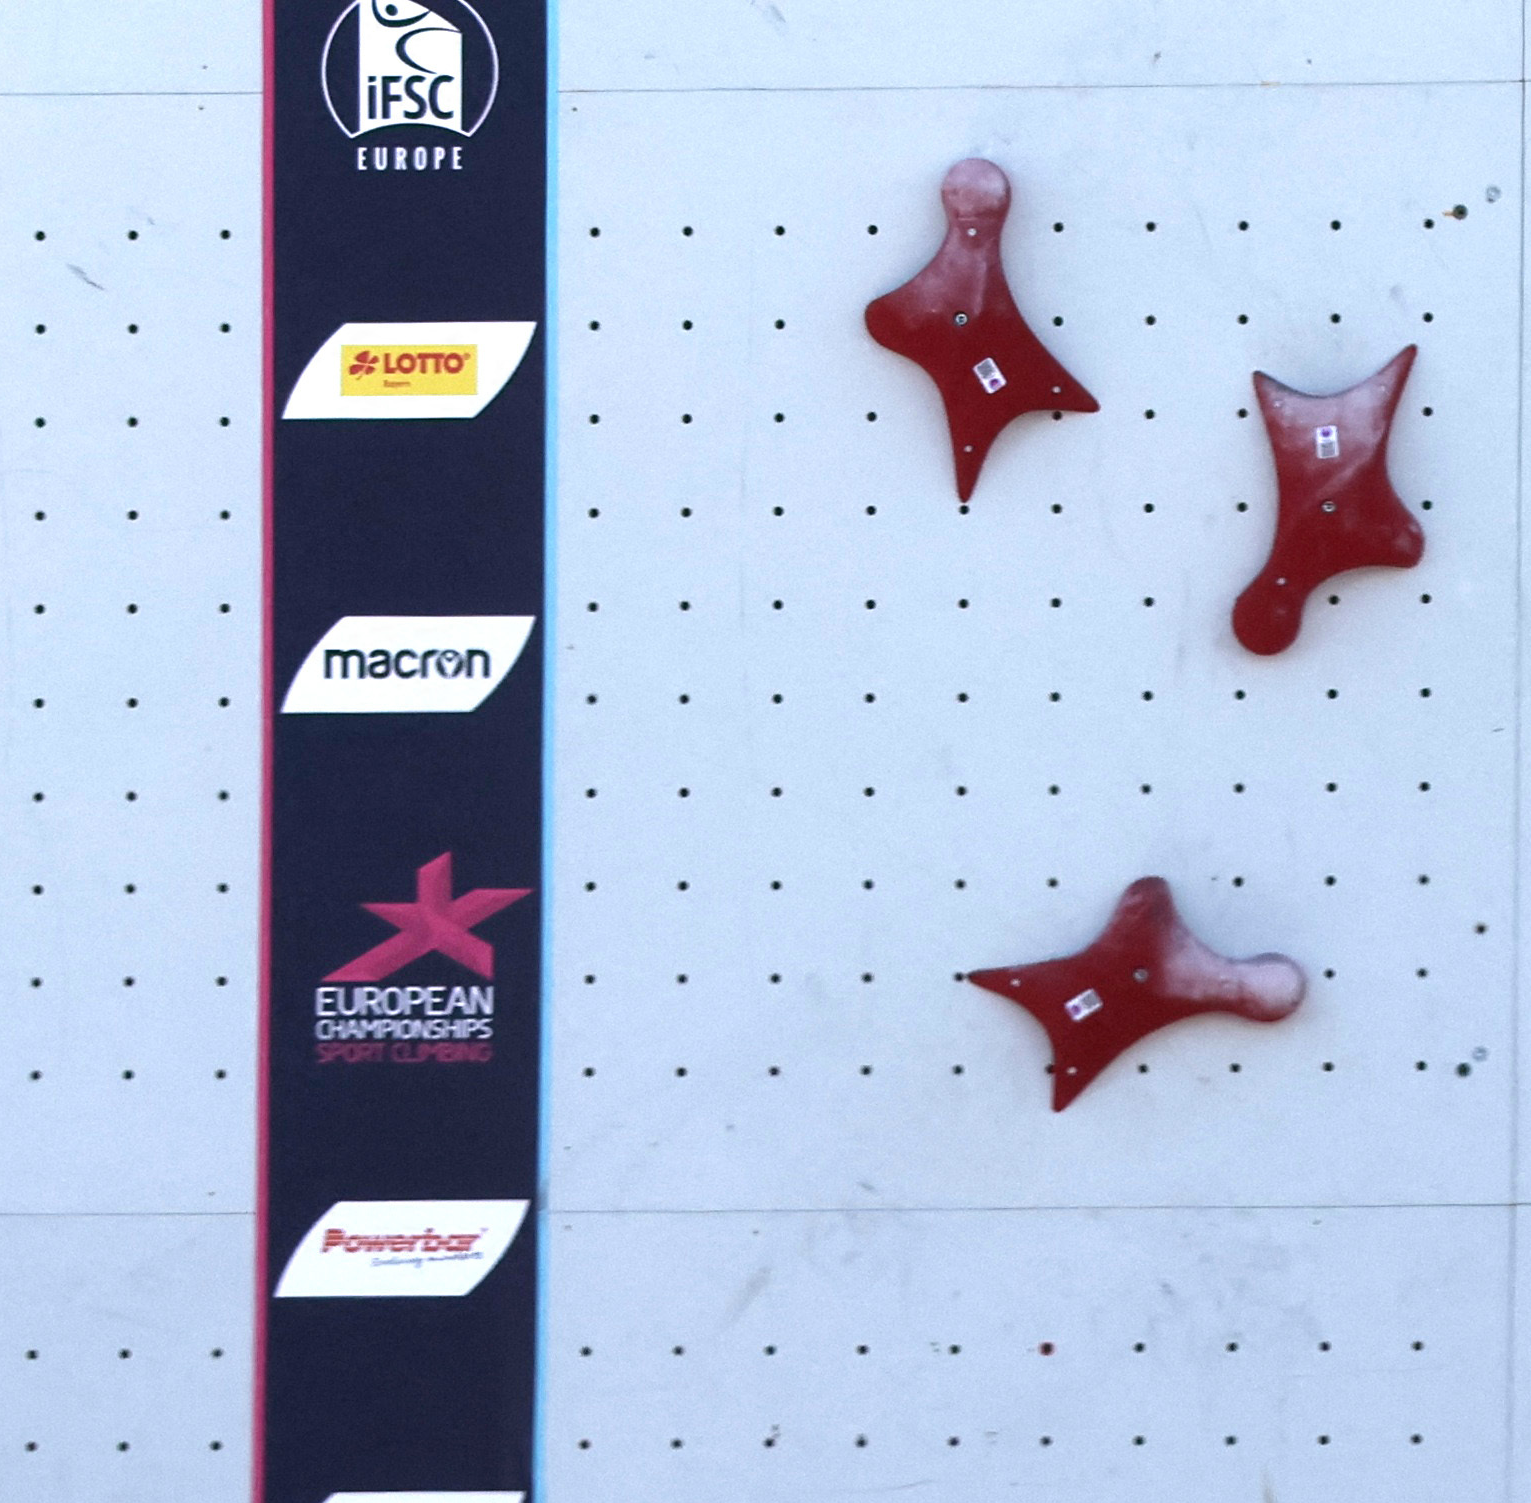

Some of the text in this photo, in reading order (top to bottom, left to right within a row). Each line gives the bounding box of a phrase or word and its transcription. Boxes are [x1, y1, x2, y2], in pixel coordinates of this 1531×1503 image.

[367, 75, 455, 120] iFSC
[357, 146, 463, 171] EUROPE
[324, 648, 491, 679] macron
[315, 986, 495, 1016] EUROPEAN
[315, 1018, 494, 1040] CHAMPIONSHIPS
